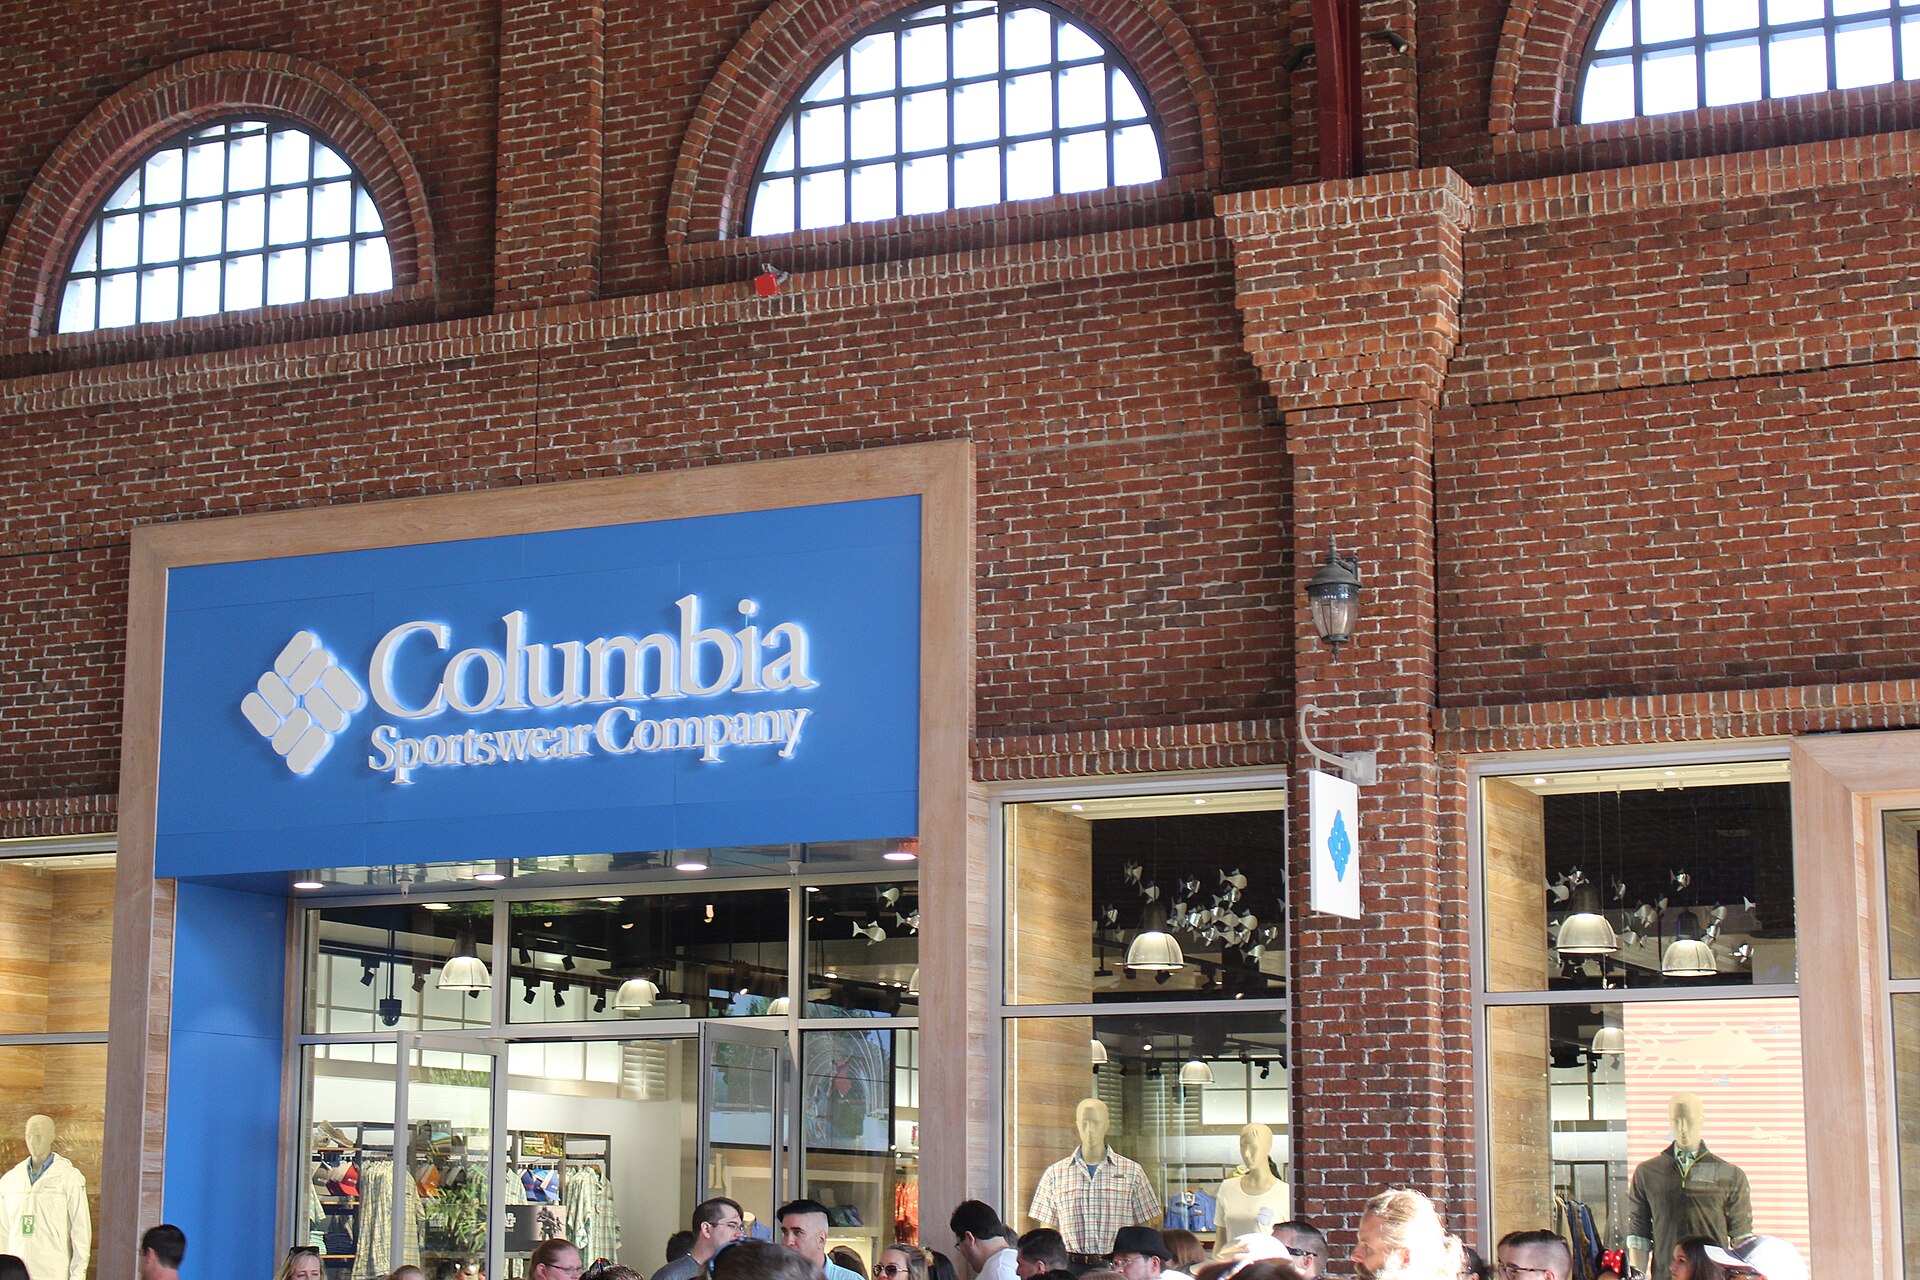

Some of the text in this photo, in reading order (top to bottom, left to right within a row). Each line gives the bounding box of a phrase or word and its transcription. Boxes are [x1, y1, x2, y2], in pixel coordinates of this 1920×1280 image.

[368, 593, 819, 718] Columbia
[368, 706, 811, 784] Sportswear Company
